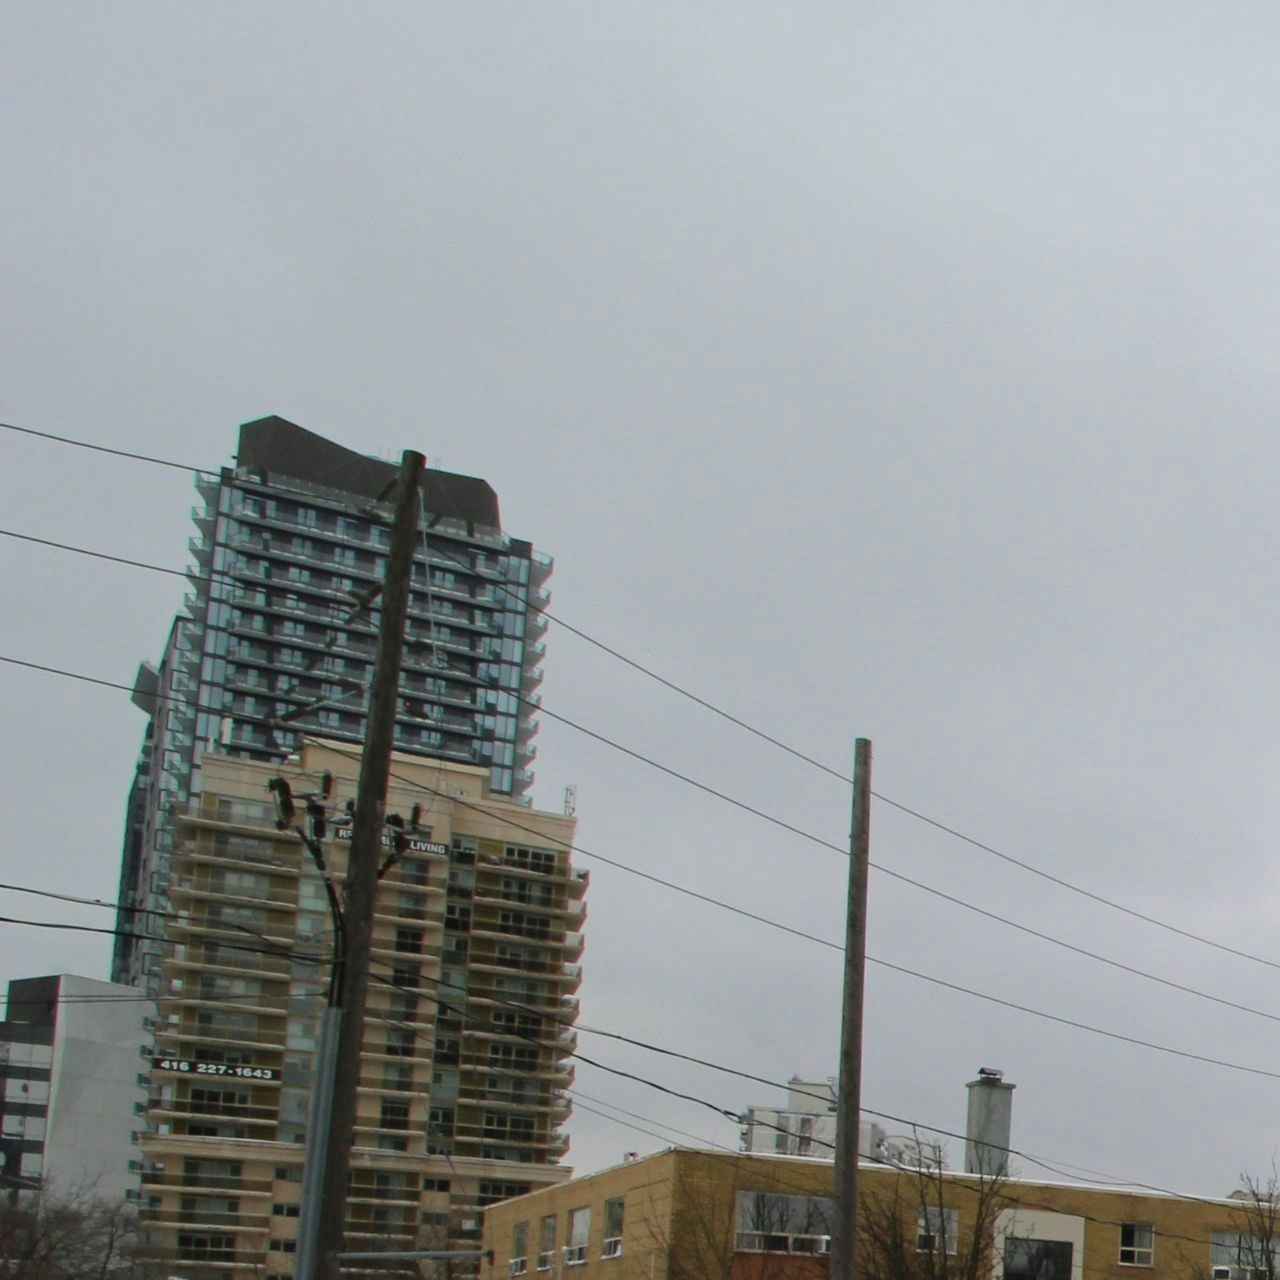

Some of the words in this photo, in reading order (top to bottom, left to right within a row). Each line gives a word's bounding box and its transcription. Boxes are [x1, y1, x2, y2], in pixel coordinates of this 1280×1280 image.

[410, 840, 446, 854] LIVING
[160, 1060, 189, 1071] 416
[196, 1063, 272, 1079] 227-1643
